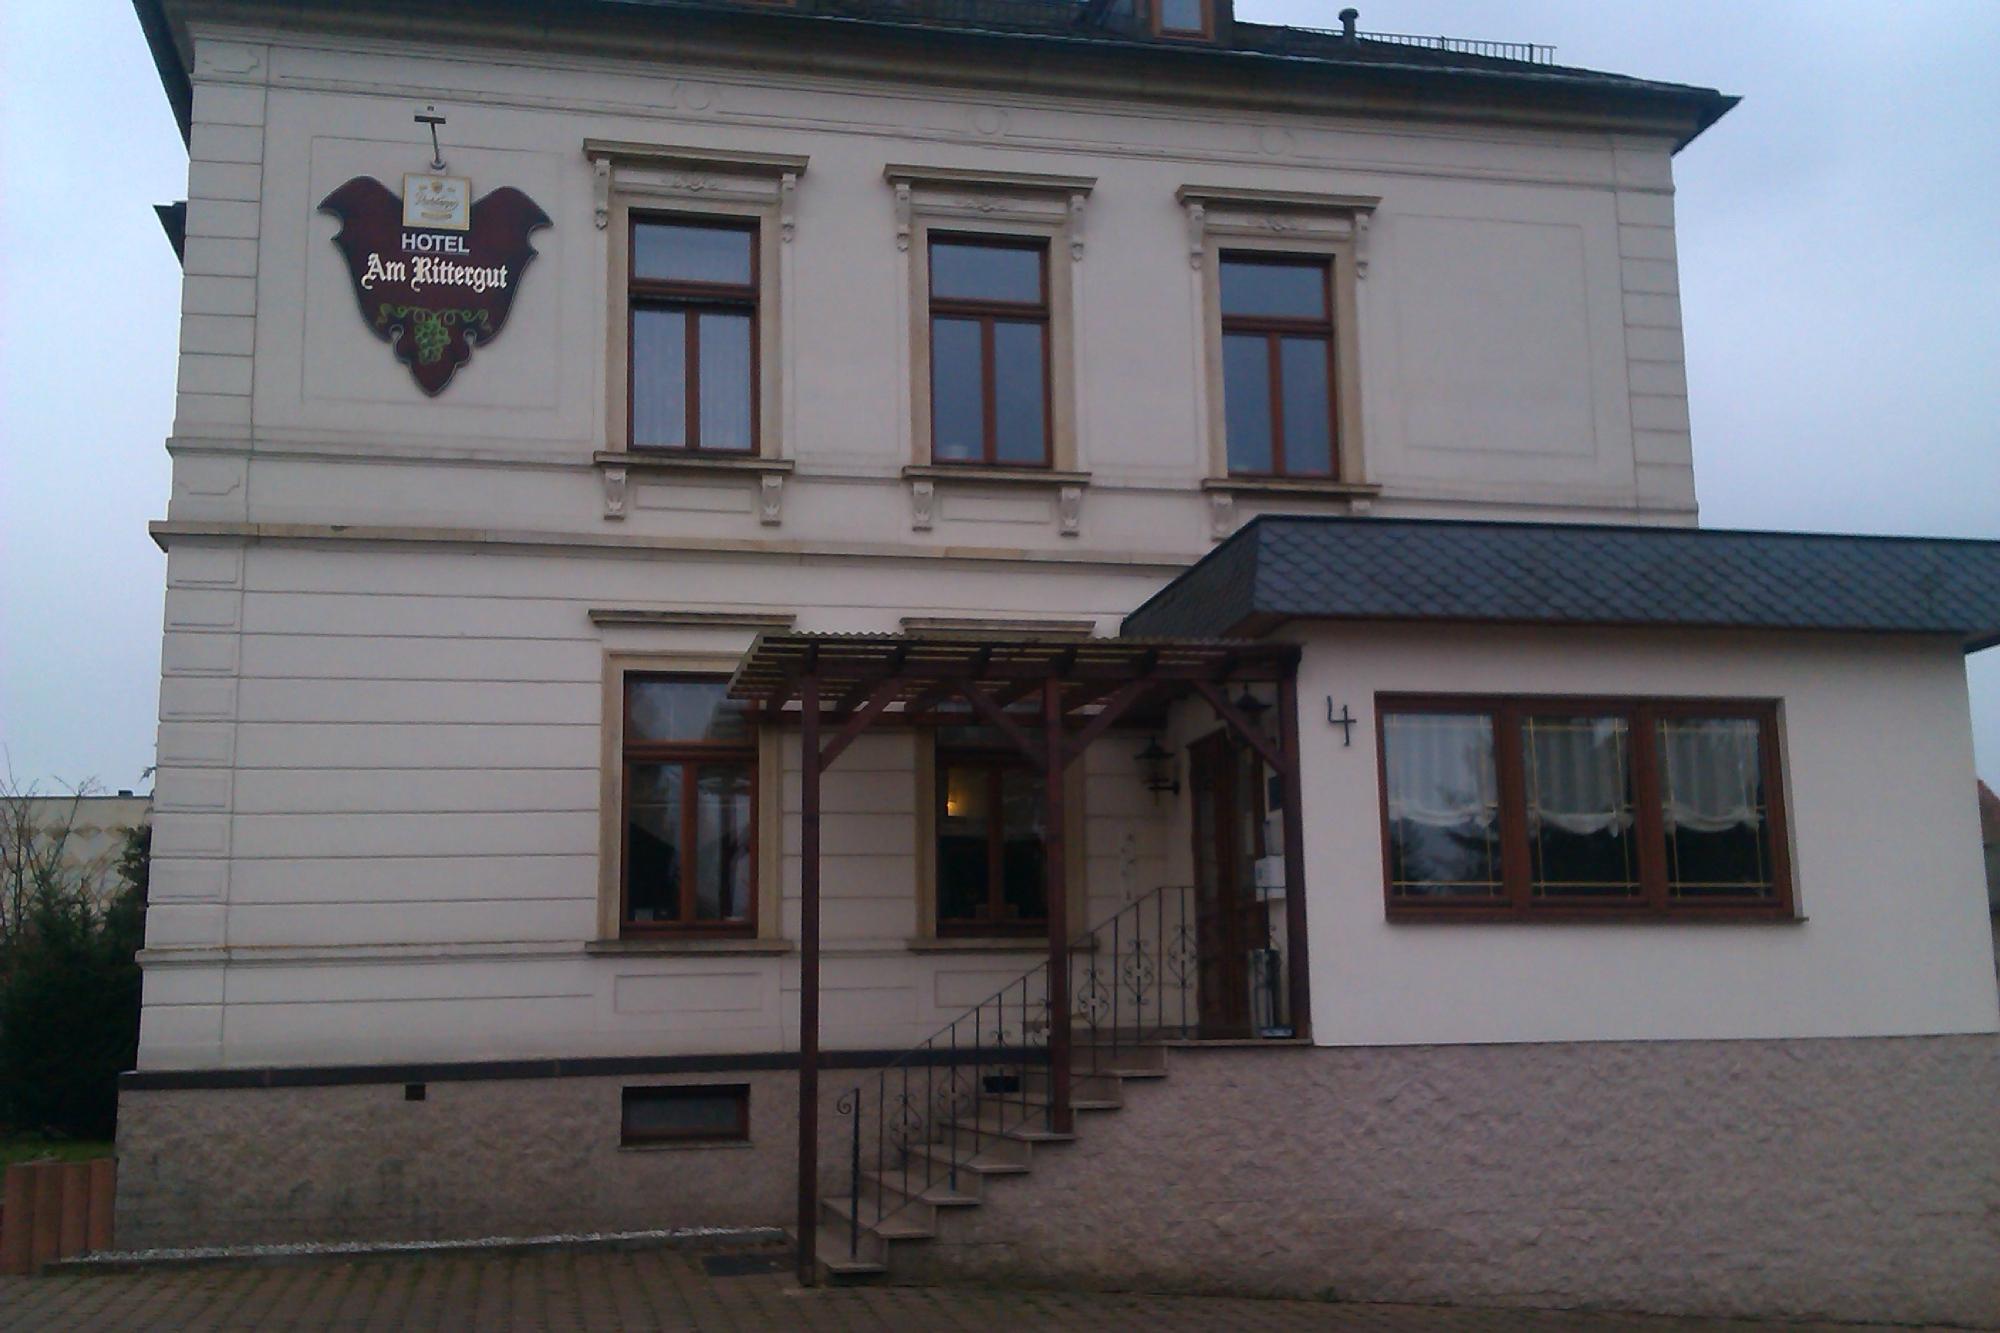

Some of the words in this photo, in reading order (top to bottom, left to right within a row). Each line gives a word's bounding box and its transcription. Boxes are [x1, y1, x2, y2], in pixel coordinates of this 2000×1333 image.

[401, 233, 470, 253] HOTEL
[361, 252, 405, 289] Am
[411, 256, 507, 293] Rittergut
[1326, 695, 1357, 747] 4
